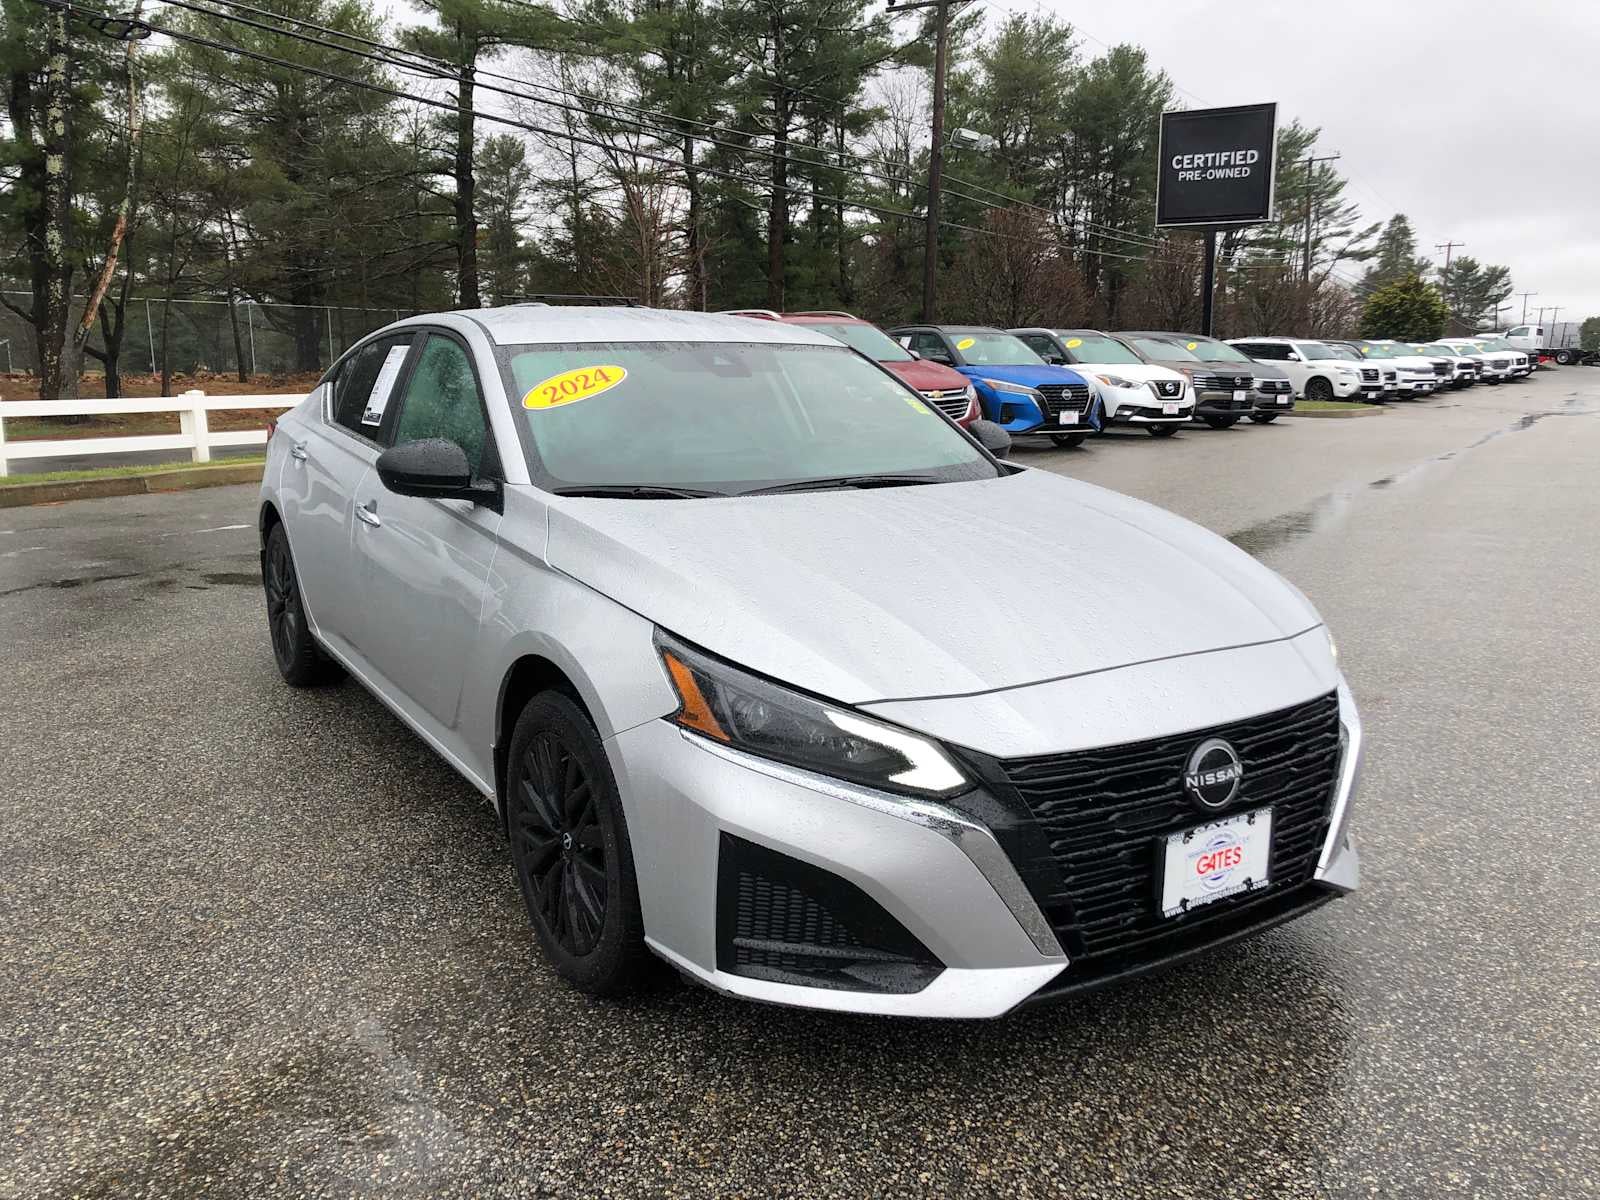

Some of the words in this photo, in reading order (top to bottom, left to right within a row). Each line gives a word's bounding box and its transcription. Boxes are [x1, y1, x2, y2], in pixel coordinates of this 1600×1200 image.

[1172, 149, 1258, 169] CERTIFIED
[1178, 167, 1251, 182] PRE-OWNED
[543, 368, 611, 403] 2024
[1185, 764, 1242, 787] NISSAN
[1196, 847, 1242, 875] GATES
